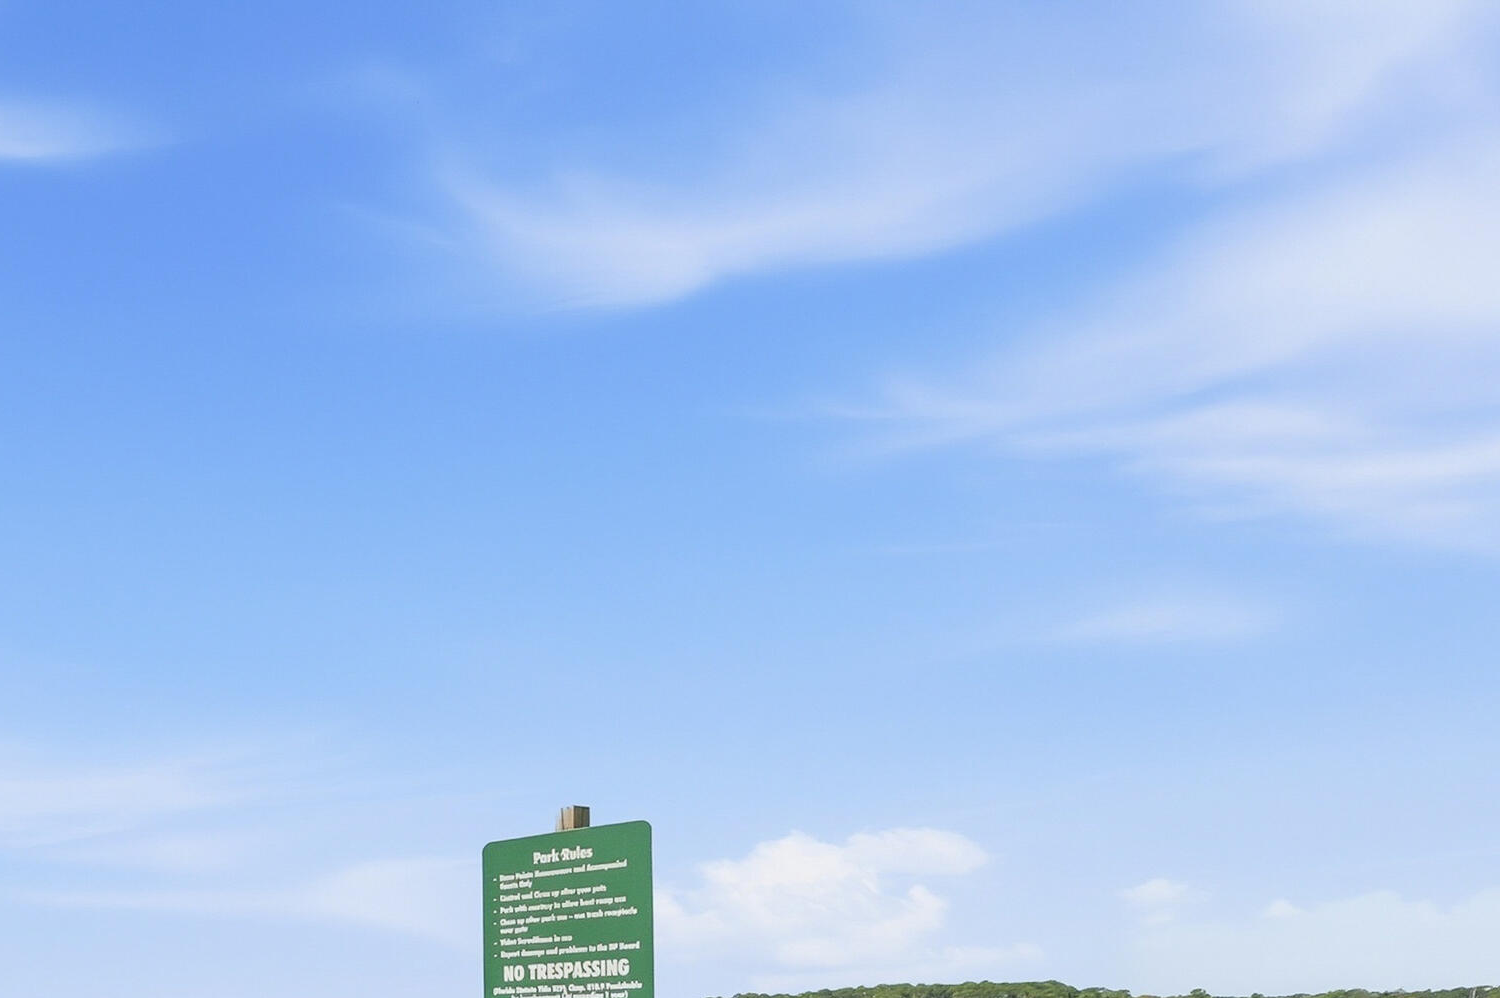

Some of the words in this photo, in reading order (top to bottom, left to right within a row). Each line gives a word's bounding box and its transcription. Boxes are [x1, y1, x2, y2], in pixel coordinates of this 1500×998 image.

[533, 848, 560, 864] Park
[560, 845, 593, 861] Rules
[503, 964, 525, 982] NO
[527, 958, 630, 981] TRESPASSING
